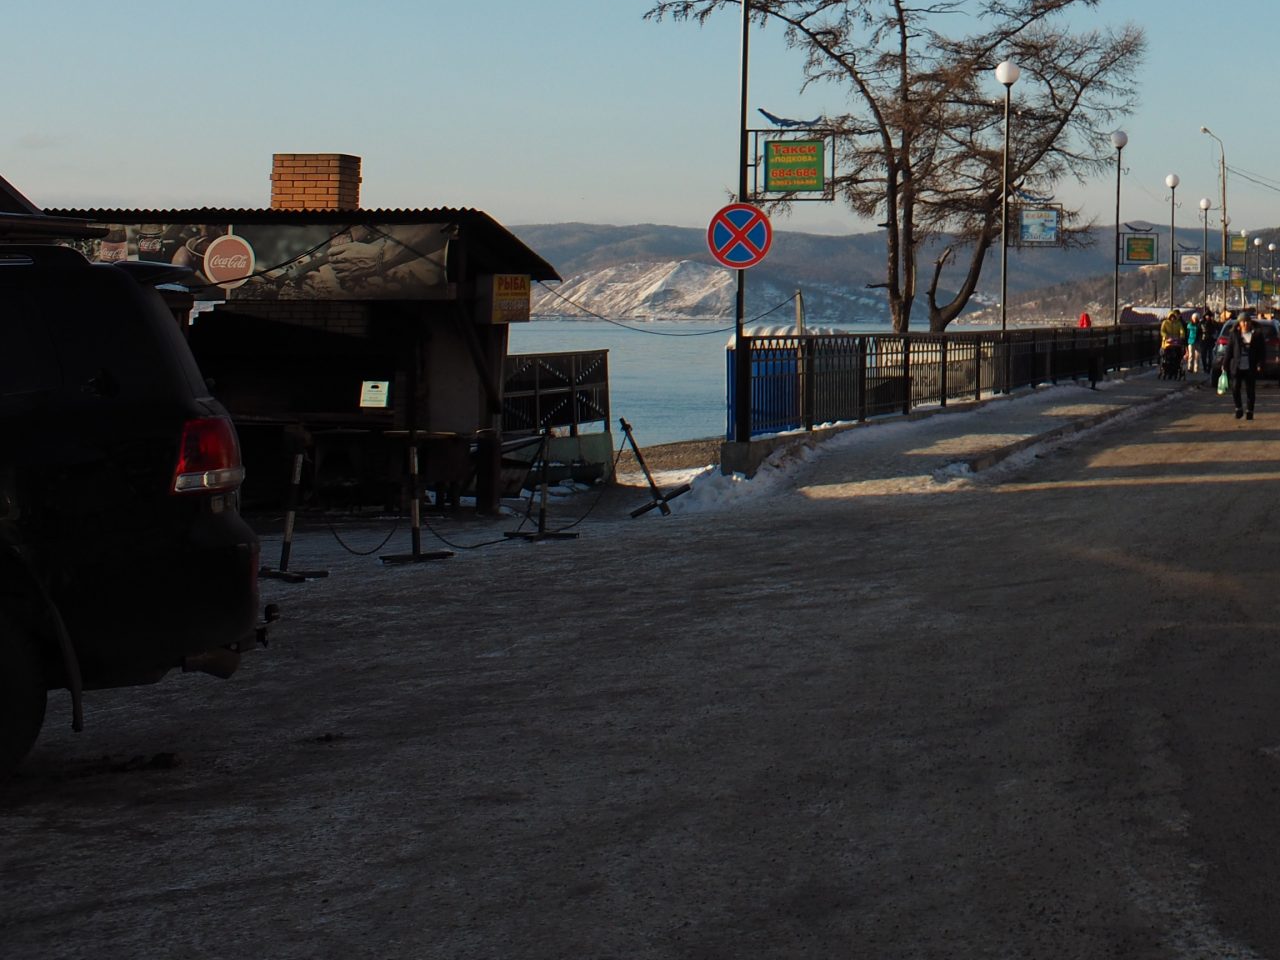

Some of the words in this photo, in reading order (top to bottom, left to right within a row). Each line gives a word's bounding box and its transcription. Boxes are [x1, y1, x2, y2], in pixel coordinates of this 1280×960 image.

[772, 143, 817, 155] Такси
[771, 168, 817, 179] 684-684
[209, 254, 248, 269] Coca-Cola
[497, 276, 526, 291] РЫБА
